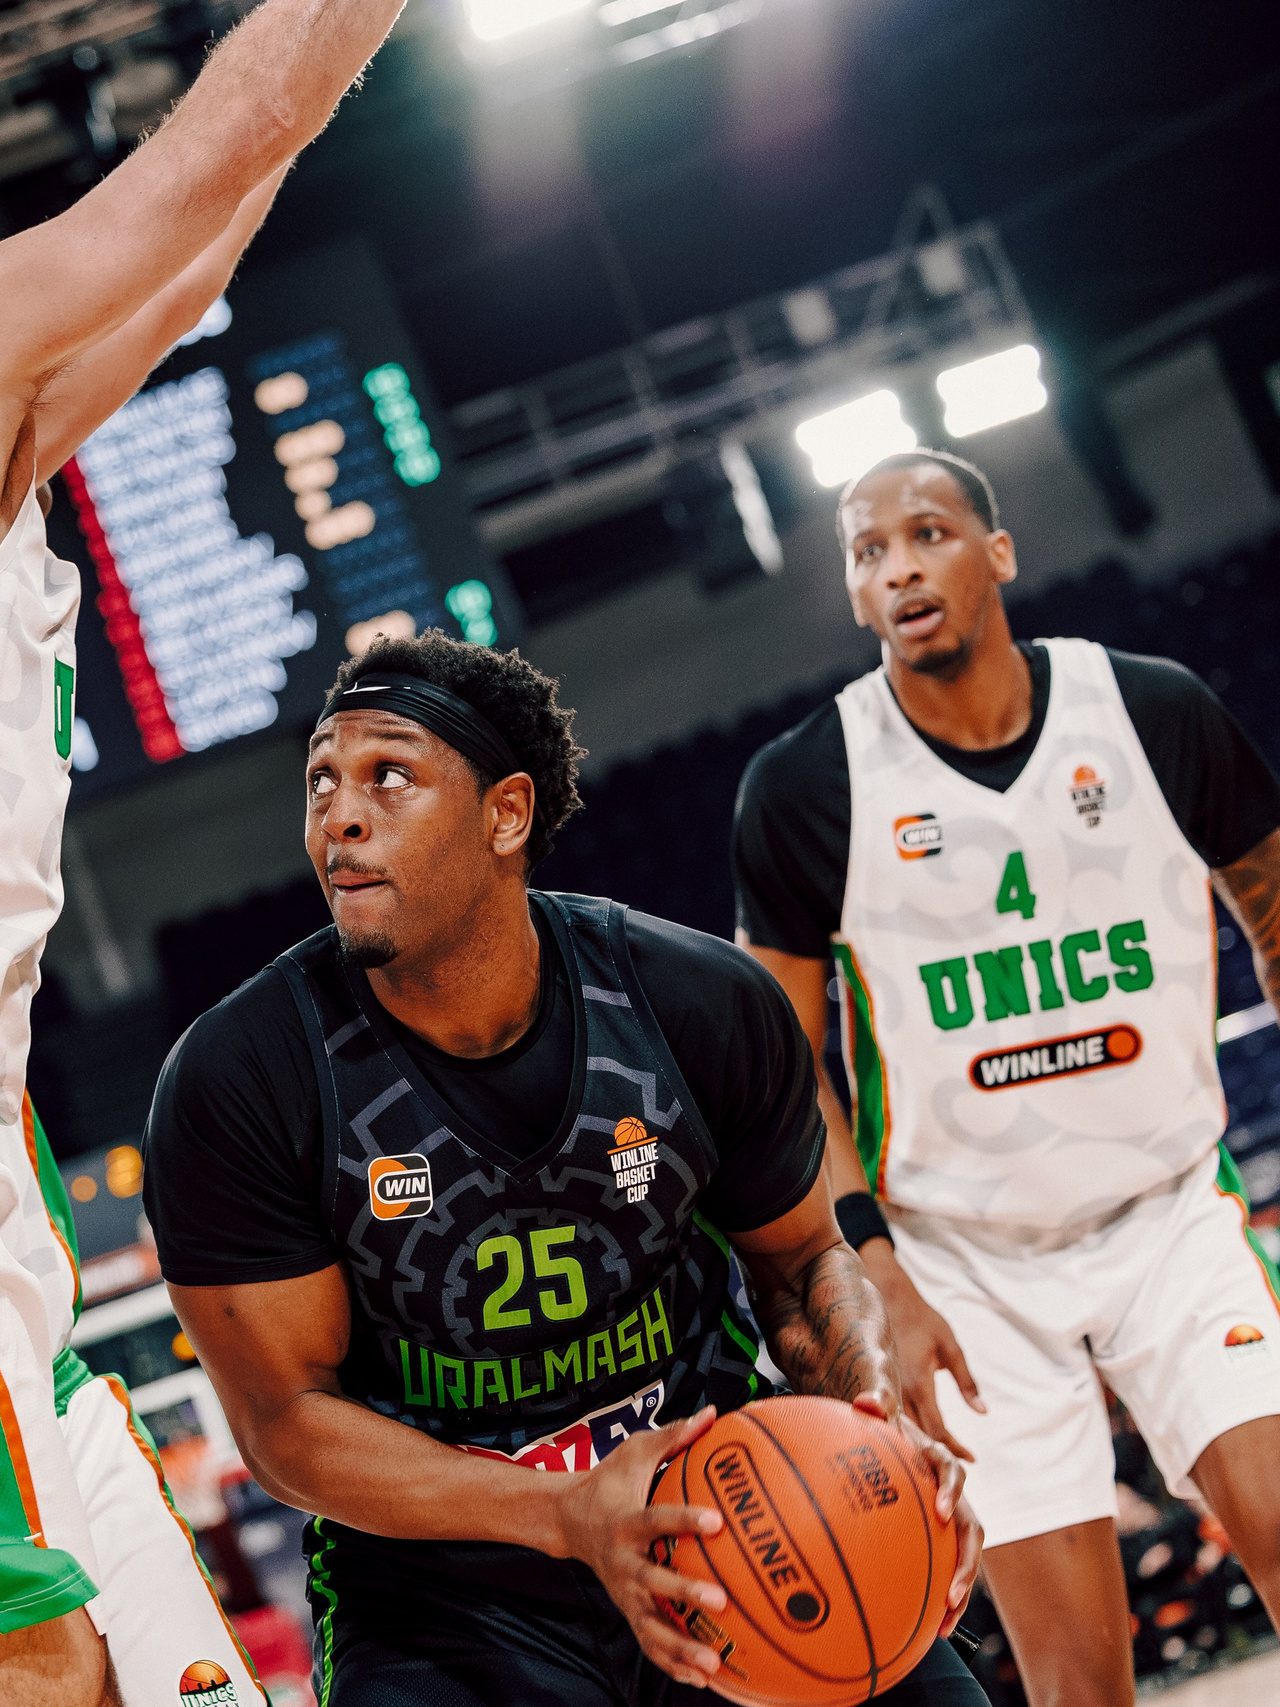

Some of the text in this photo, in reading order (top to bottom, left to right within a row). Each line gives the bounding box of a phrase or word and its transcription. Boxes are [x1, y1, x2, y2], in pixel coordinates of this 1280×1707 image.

[996, 851, 1036, 919] 4
[918, 920, 1154, 1031] UNICS
[980, 1036, 1104, 1086] WINLINE
[385, 1176, 426, 1197] WIN
[610, 1142, 659, 1172] WINLINE
[616, 1163, 656, 1189] BASKET
[627, 1184, 649, 1204] CUP
[476, 1225, 588, 1331] 25
[399, 1287, 674, 1409] URALMASH
[715, 1453, 800, 1589] WINLINE
